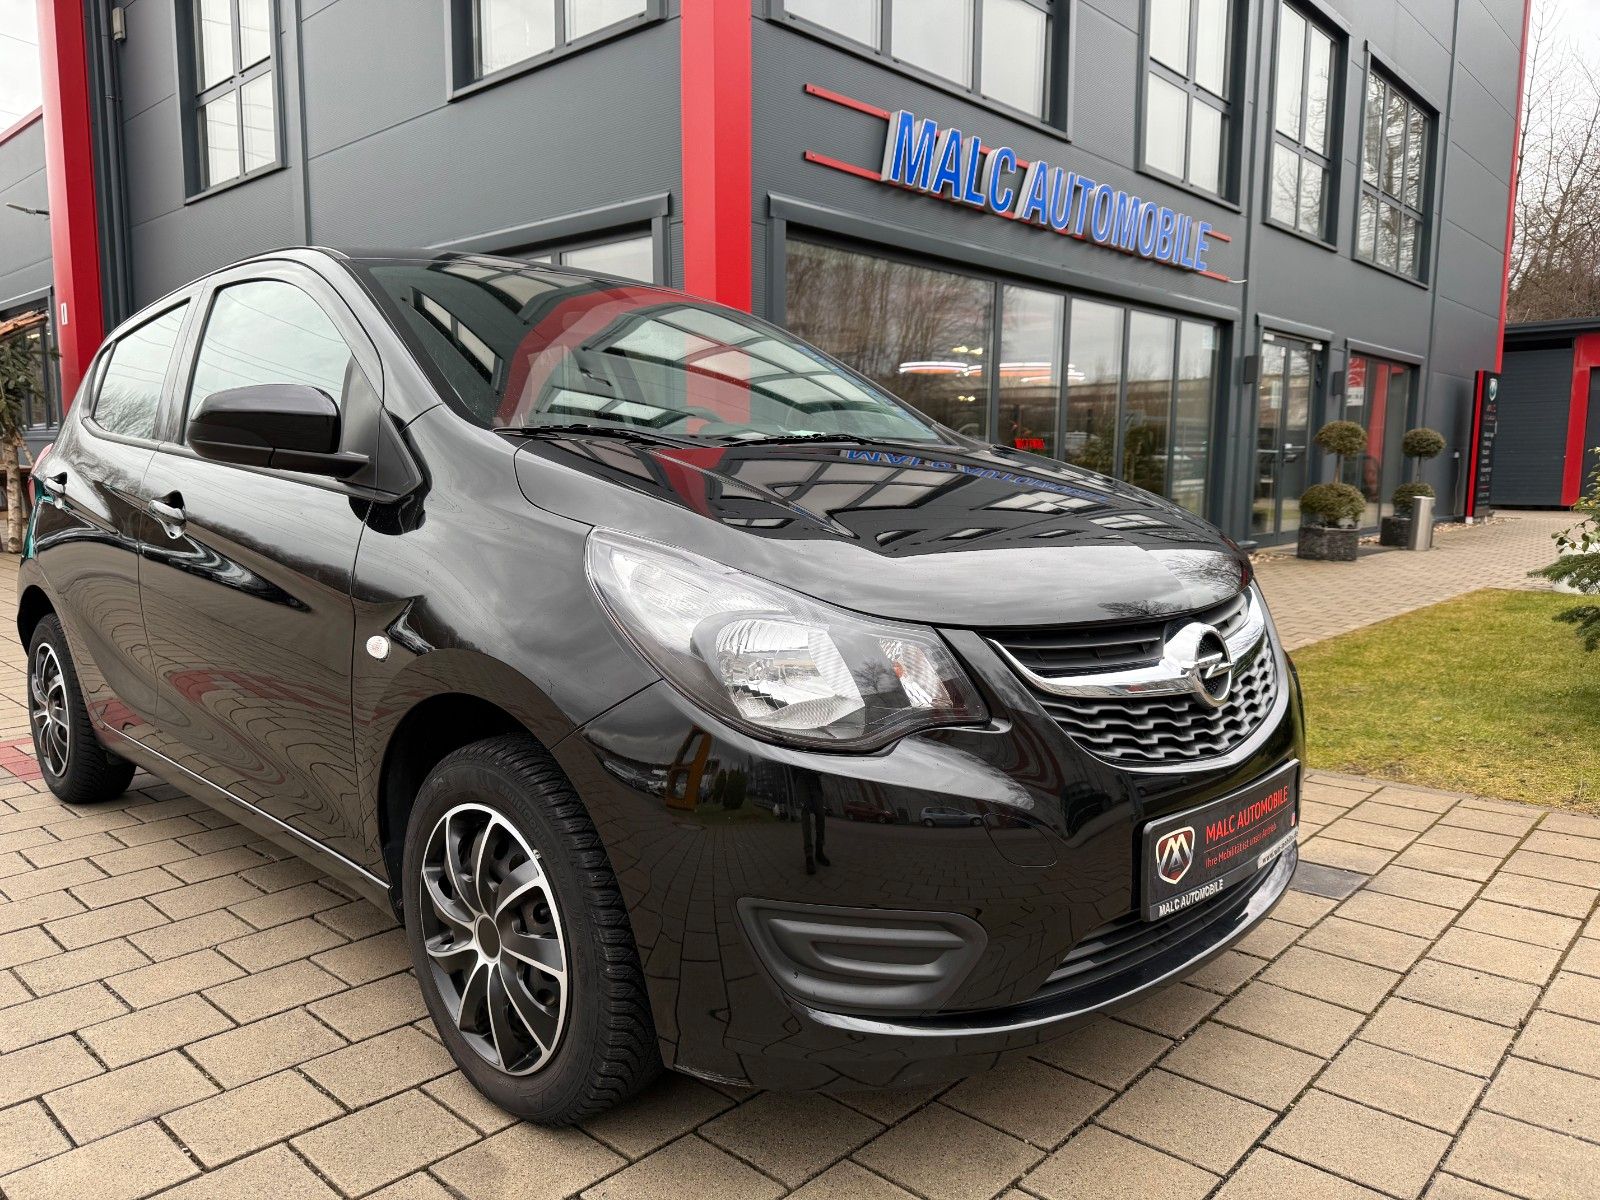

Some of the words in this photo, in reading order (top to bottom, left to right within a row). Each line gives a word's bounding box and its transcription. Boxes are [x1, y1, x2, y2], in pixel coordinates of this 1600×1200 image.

[889, 109, 1017, 214] MALC
[1021, 159, 1213, 271] AUTOMOBILE
[1206, 814, 1235, 844] MALC
[1237, 785, 1288, 829] AUTOMOBILE
[1205, 857, 1217, 869] Ihre
[1158, 898, 1180, 917] MALC
[1180, 879, 1224, 911] AUTOMOBILE
